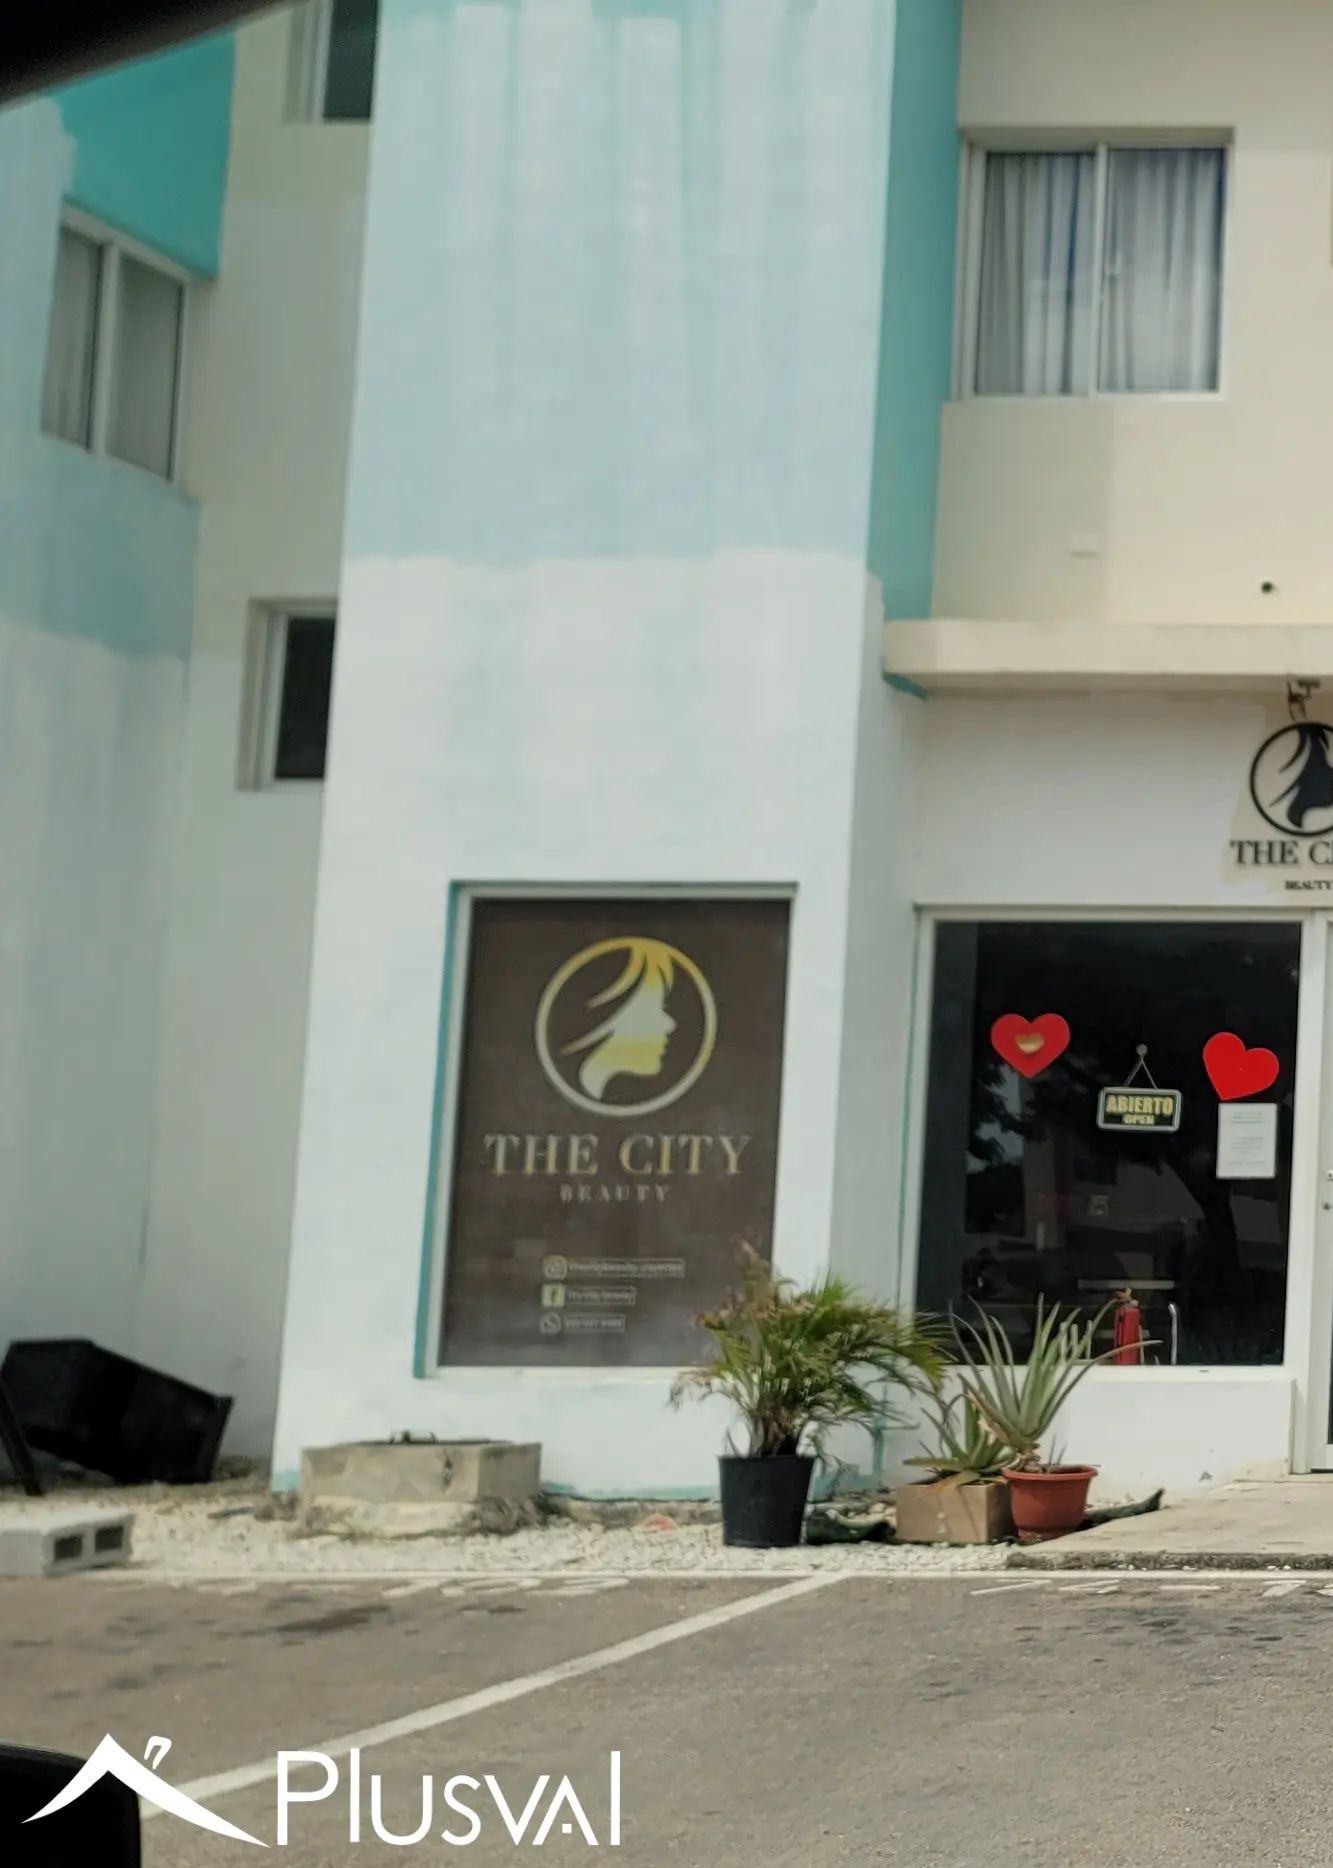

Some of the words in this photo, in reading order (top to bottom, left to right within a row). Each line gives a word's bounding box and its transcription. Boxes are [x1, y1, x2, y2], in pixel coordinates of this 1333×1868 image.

[1229, 840, 1300, 866] THE
[1284, 880, 1333, 891] BEAUTY
[1106, 1094, 1174, 1115] ABIERTO
[1122, 1113, 1156, 1125] OPEN
[484, 1134, 599, 1176] THE
[619, 1134, 752, 1176] CITY
[560, 1184, 671, 1204] BEAUTY
